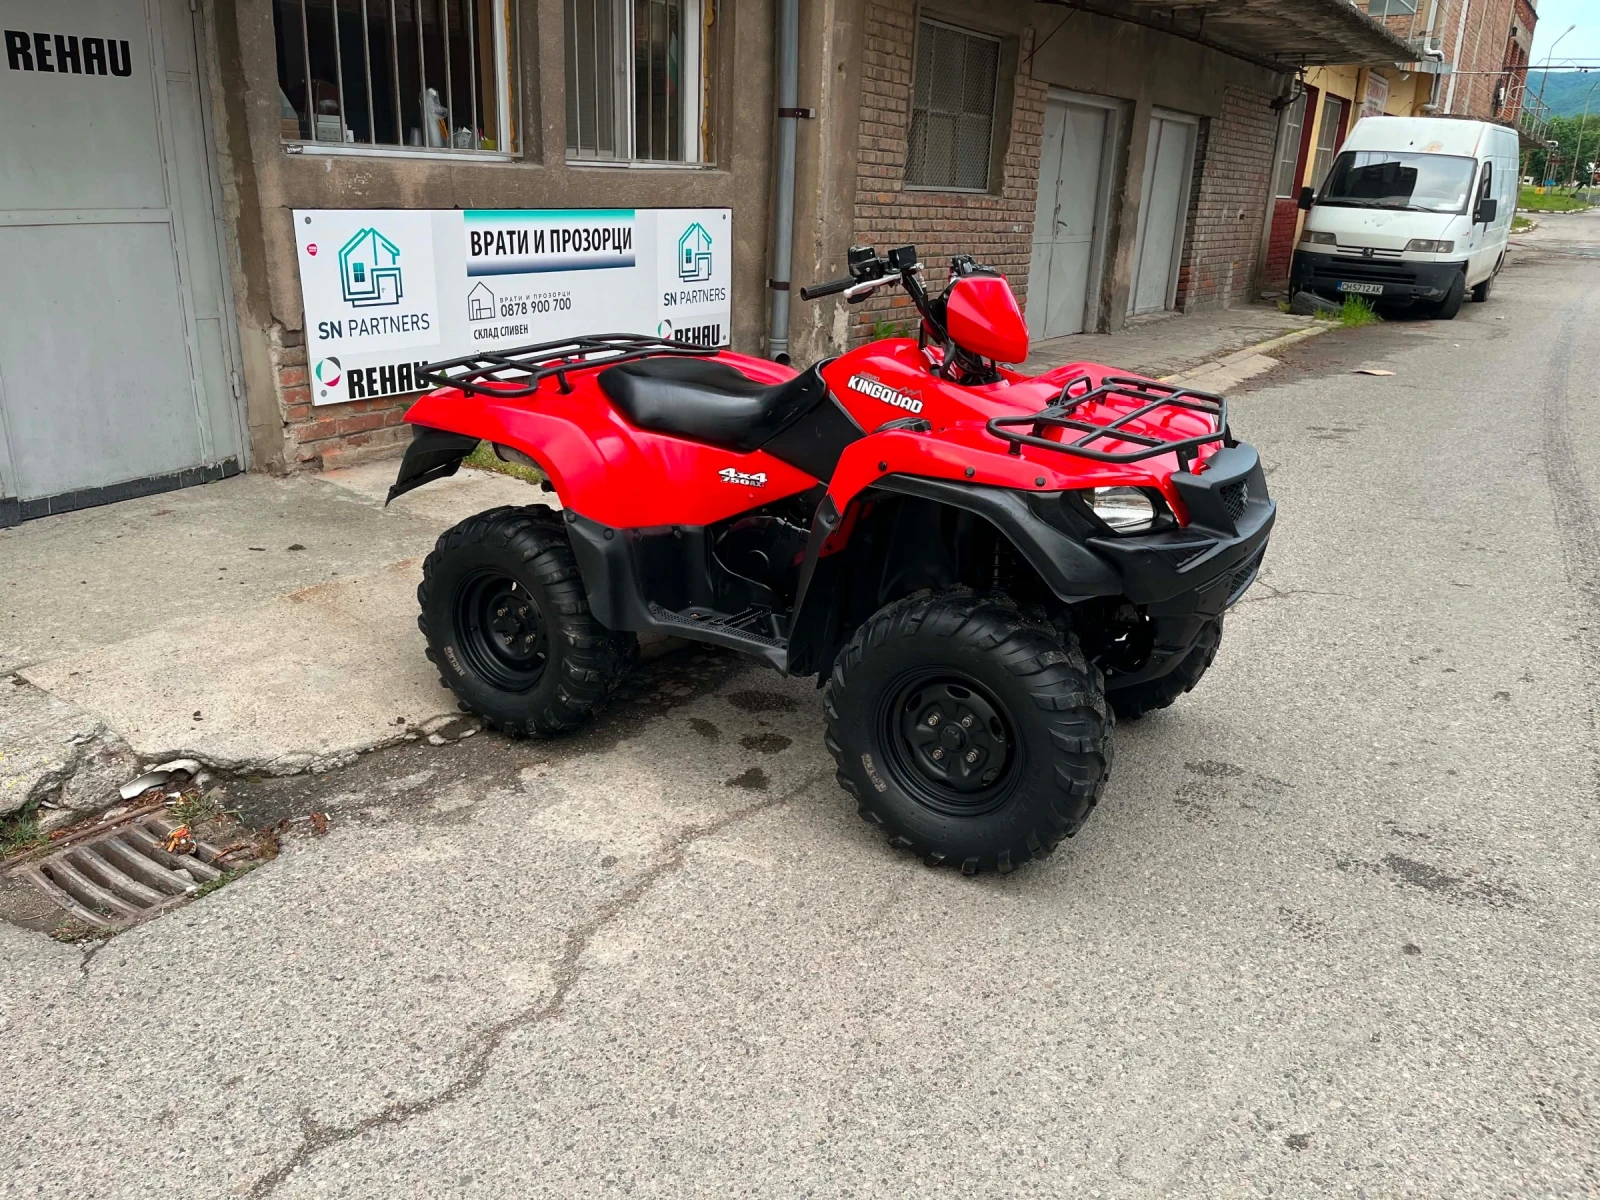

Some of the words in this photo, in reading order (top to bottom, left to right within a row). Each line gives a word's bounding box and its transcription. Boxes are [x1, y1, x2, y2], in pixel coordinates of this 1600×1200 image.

[4, 30, 132, 77] REHAU
[470, 230, 529, 257] ВРАТИ
[533, 229, 545, 254] И
[549, 227, 632, 254] ПРОЗОРЦИ
[499, 295, 523, 303] ВРАТИ
[533, 291, 571, 300] ПРОЗОРЦИ
[500, 302, 528, 317] 0878
[531, 299, 550, 313] 900
[553, 297, 571, 311] 700
[663, 291, 677, 306] SN
[680, 287, 726, 305] PARTNERS
[318, 320, 343, 340] SN
[348, 313, 430, 337] PARTNERS
[473, 326, 499, 340] СКЛАД
[500, 323, 529, 337] СЛИВЕН
[847, 375, 924, 414] KINGQUAD
